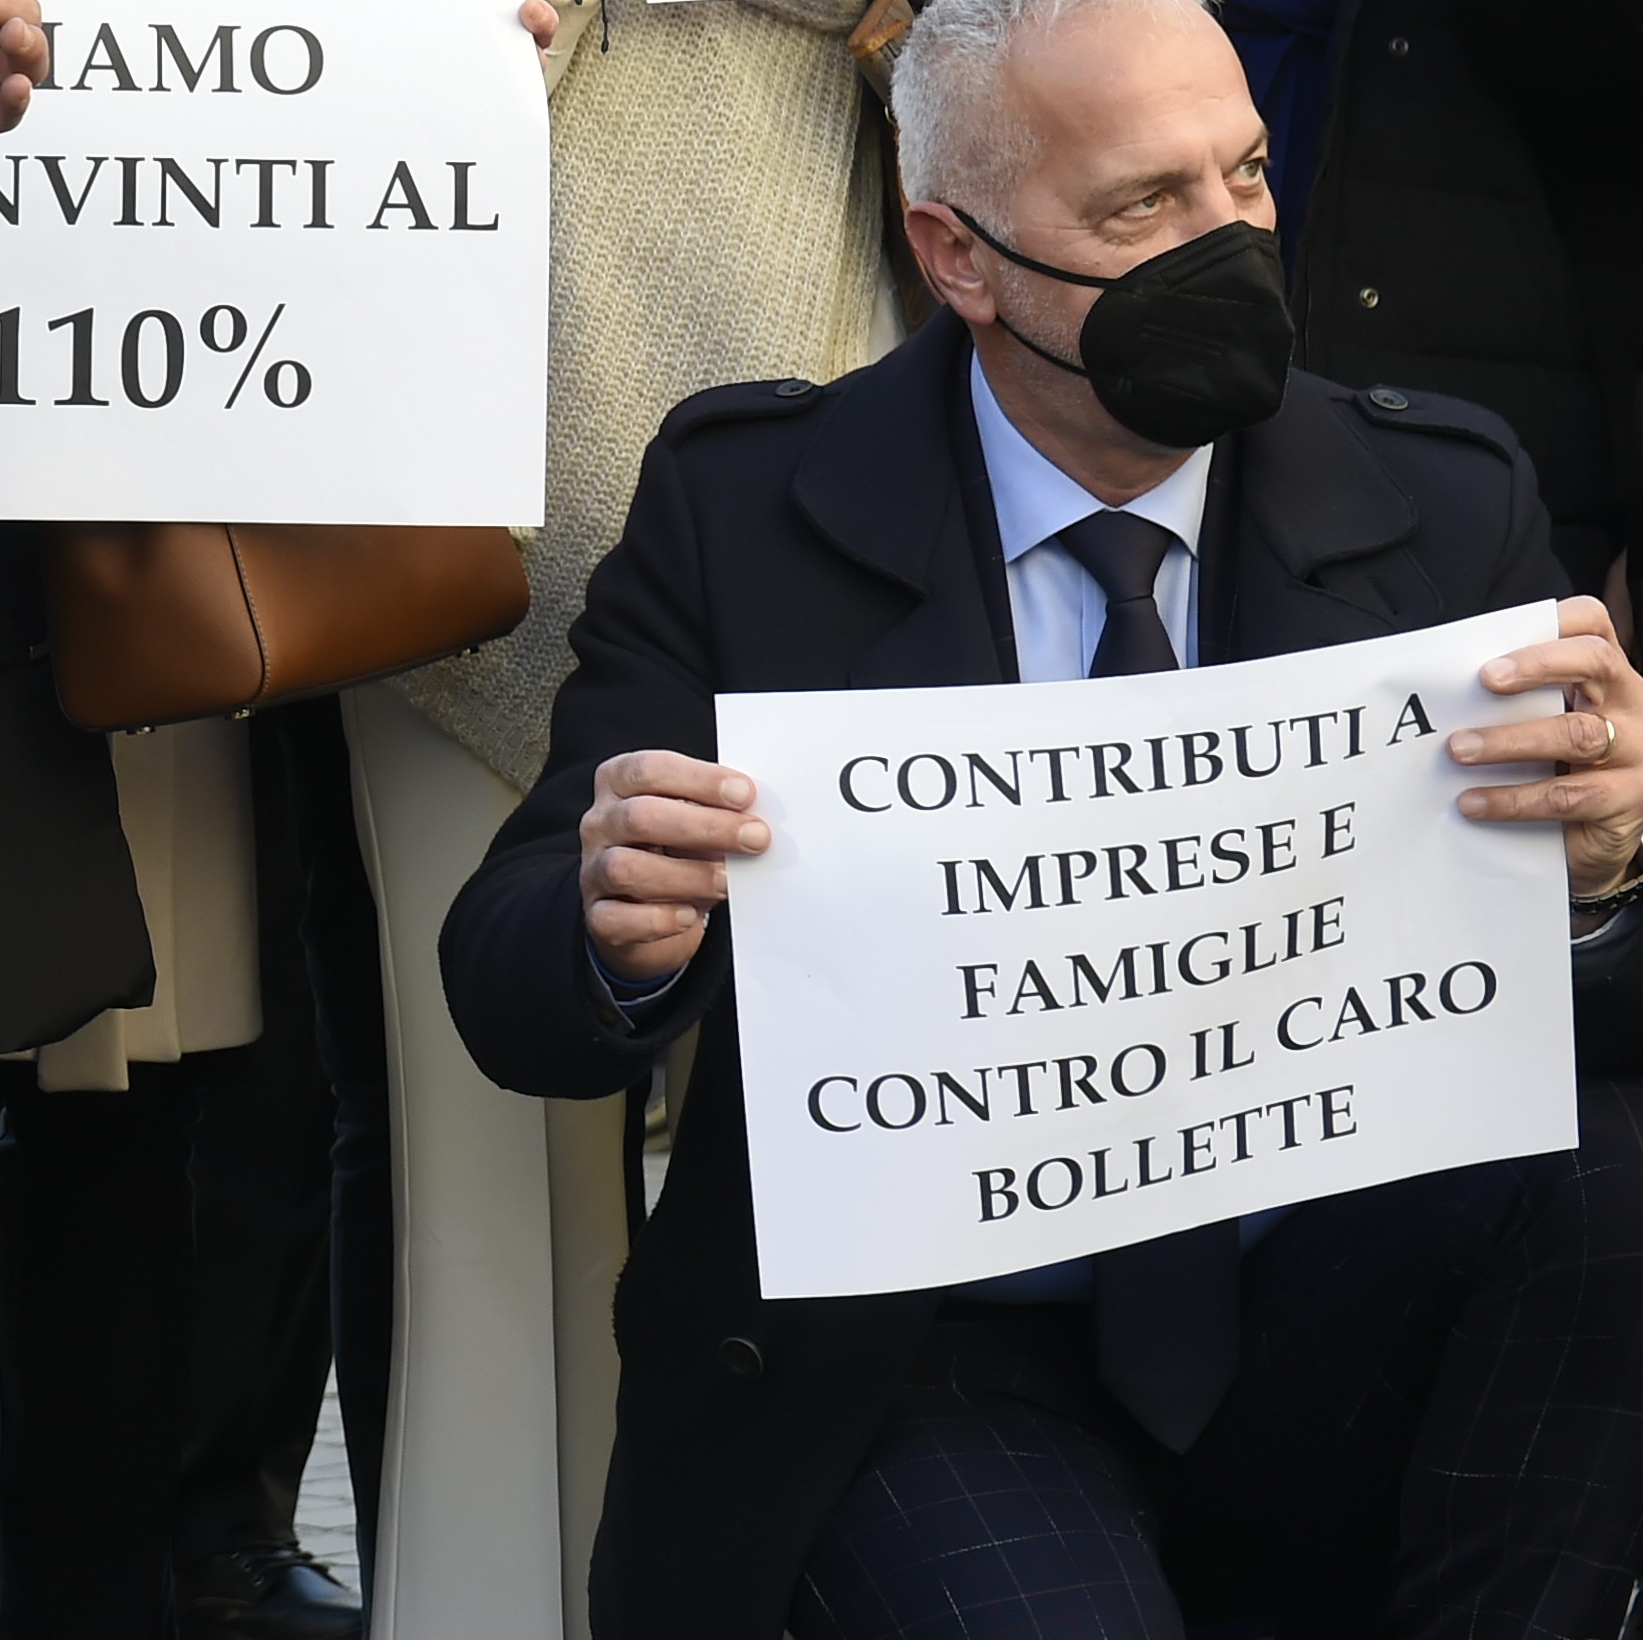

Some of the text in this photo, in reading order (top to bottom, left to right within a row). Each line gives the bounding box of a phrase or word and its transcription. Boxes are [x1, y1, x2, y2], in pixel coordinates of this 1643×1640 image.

[32, 22, 326, 96] IAMO
[365, 160, 500, 231] AL
[839, 692, 1438, 813] CONTRIBUTI A
[936, 801, 1356, 916] IMPRESE E
[955, 896, 1345, 1020] FAMIGLIE
[807, 961, 1497, 1133] CONTRO IL CARO
[971, 1084, 1357, 1223] BOLLETTE
